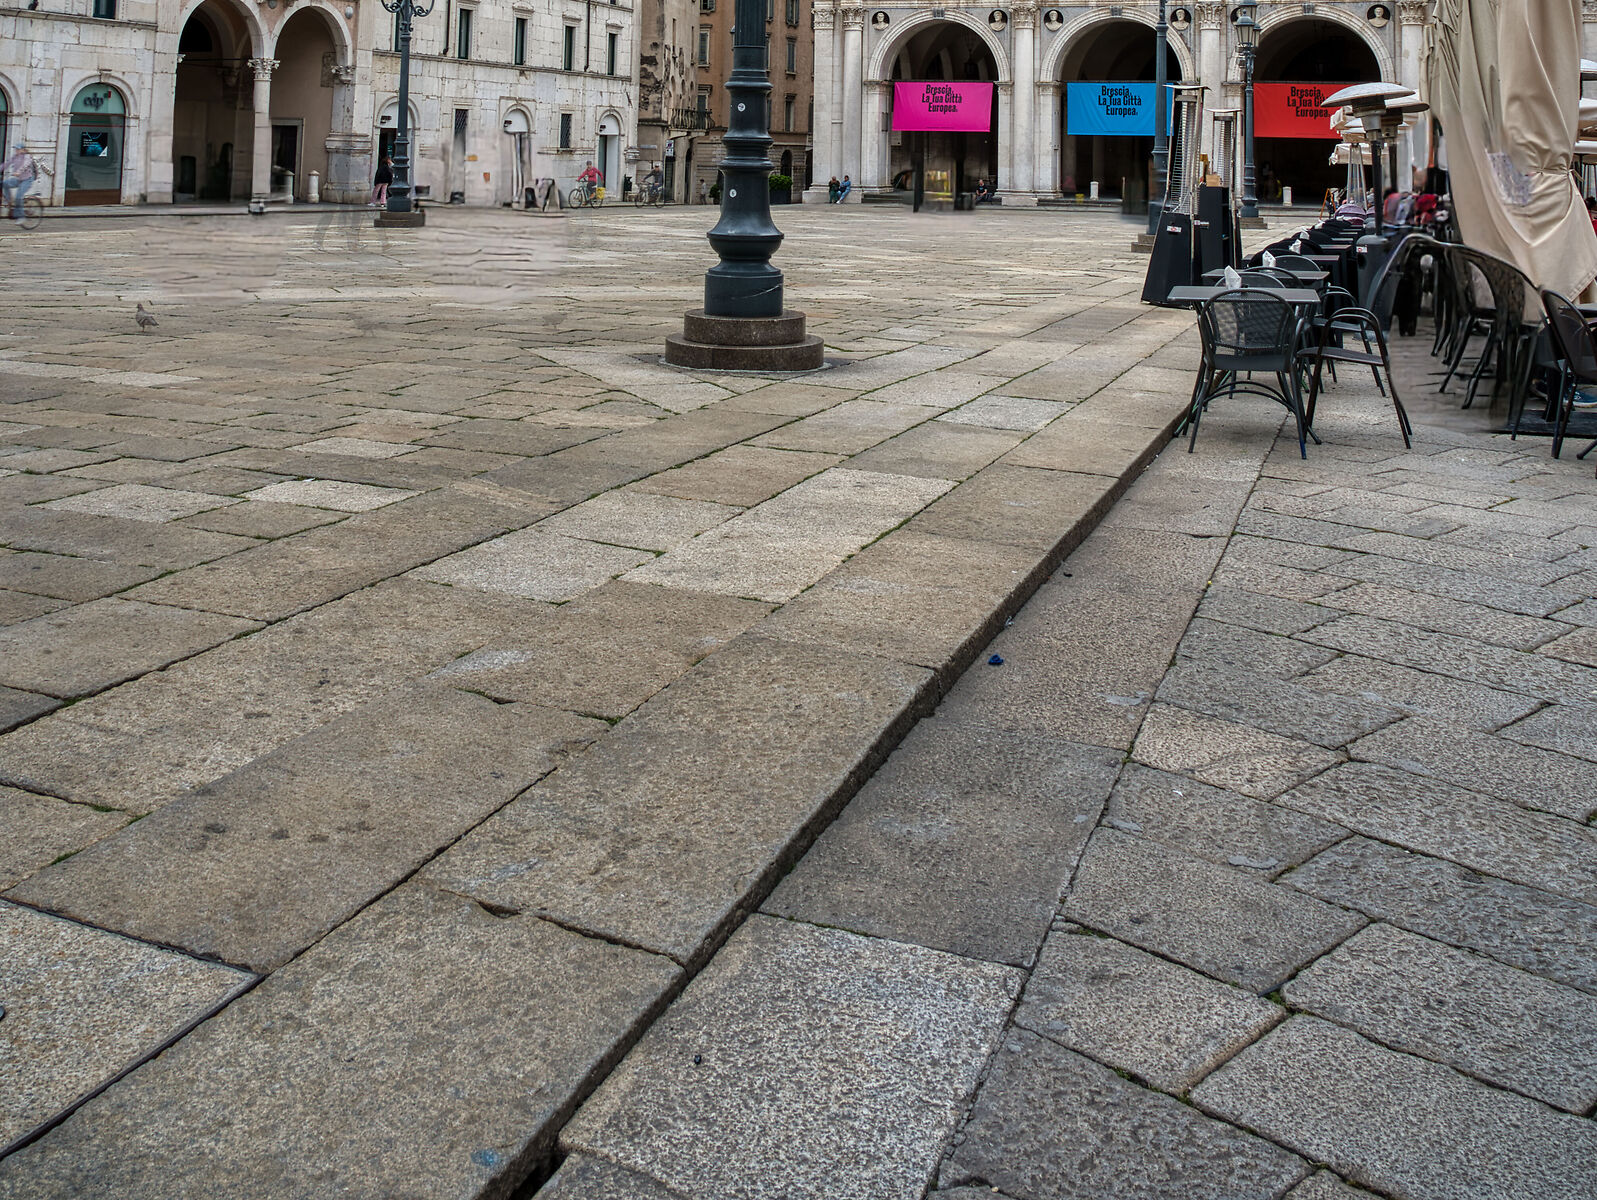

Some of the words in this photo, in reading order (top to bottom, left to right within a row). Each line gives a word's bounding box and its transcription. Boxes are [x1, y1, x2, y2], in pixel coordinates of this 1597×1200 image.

[922, 93, 930, 103] La
[932, 93, 943, 103] Tua
[1098, 95, 1107, 106] La
[1109, 95, 1121, 106] Tua
[1123, 95, 1142, 106] Città
[1287, 96, 1296, 107] La
[1299, 96, 1312, 107] Tua
